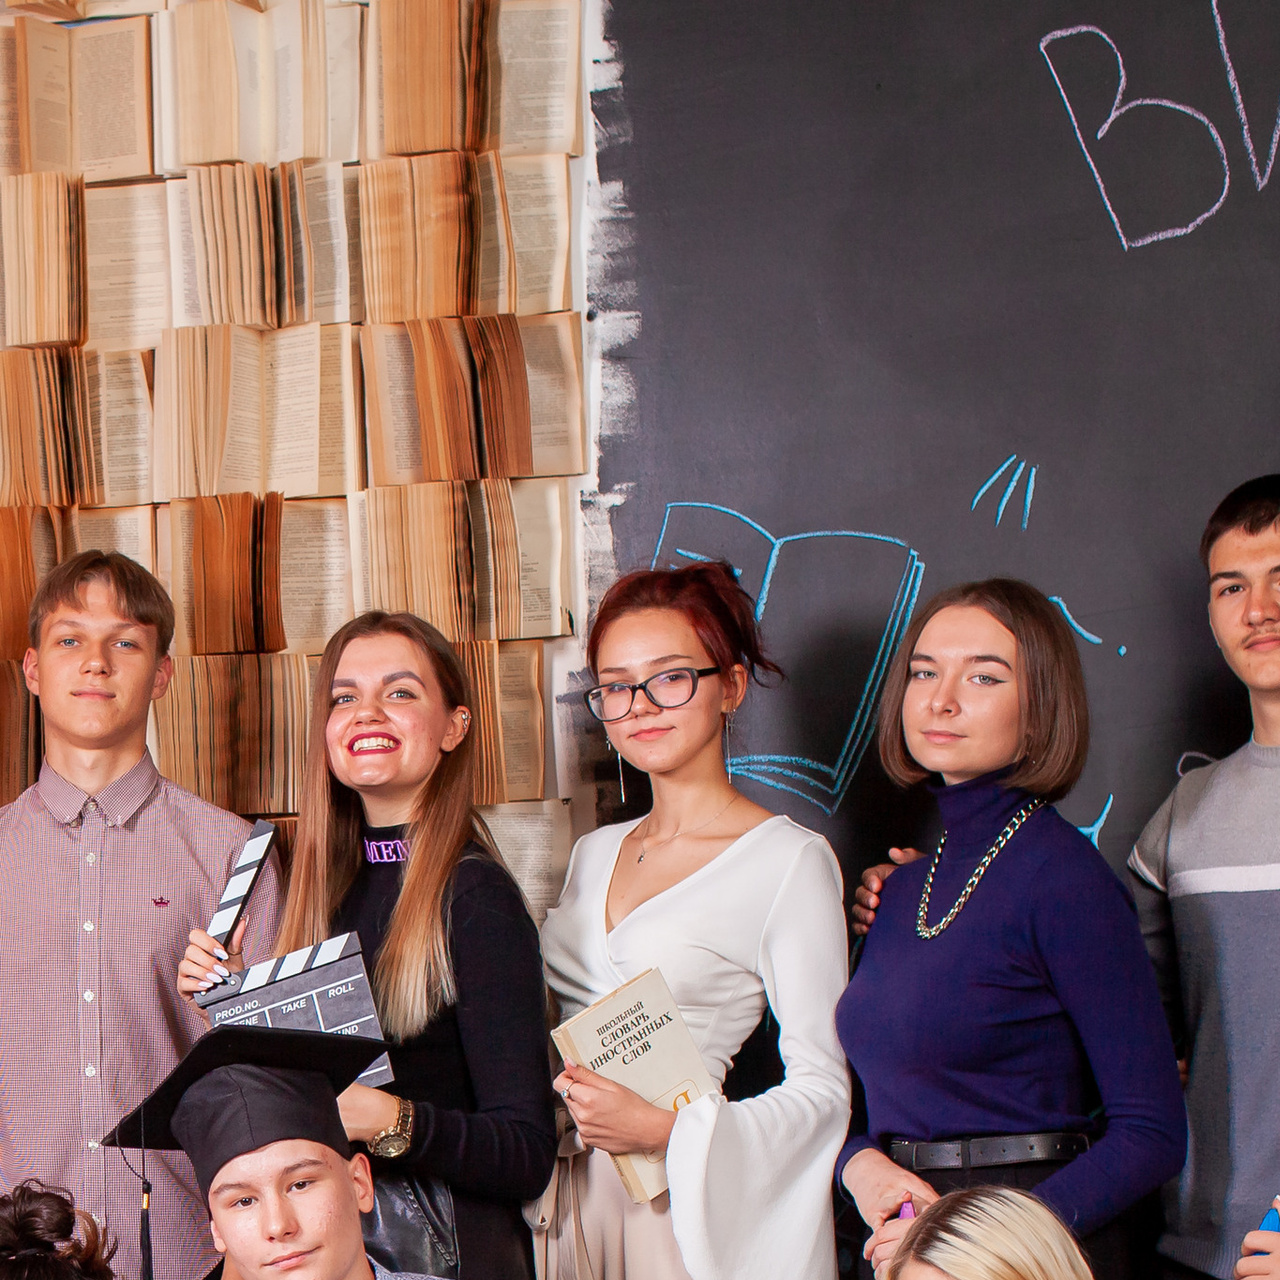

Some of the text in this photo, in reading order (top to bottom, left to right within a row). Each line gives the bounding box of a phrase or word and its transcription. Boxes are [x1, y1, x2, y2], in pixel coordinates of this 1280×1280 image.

[328, 983, 355, 998] ROLL
[214, 999, 261, 1021] PROD.NO.
[280, 999, 307, 1014] TAKE
[596, 1001, 645, 1037] ШКОЛЬНЫЙ
[589, 1011, 673, 1071] ИНОСТРАННЫХ
[600, 1012, 650, 1048] СЛОВАРЬ
[621, 1040, 652, 1066] СЛОВ
